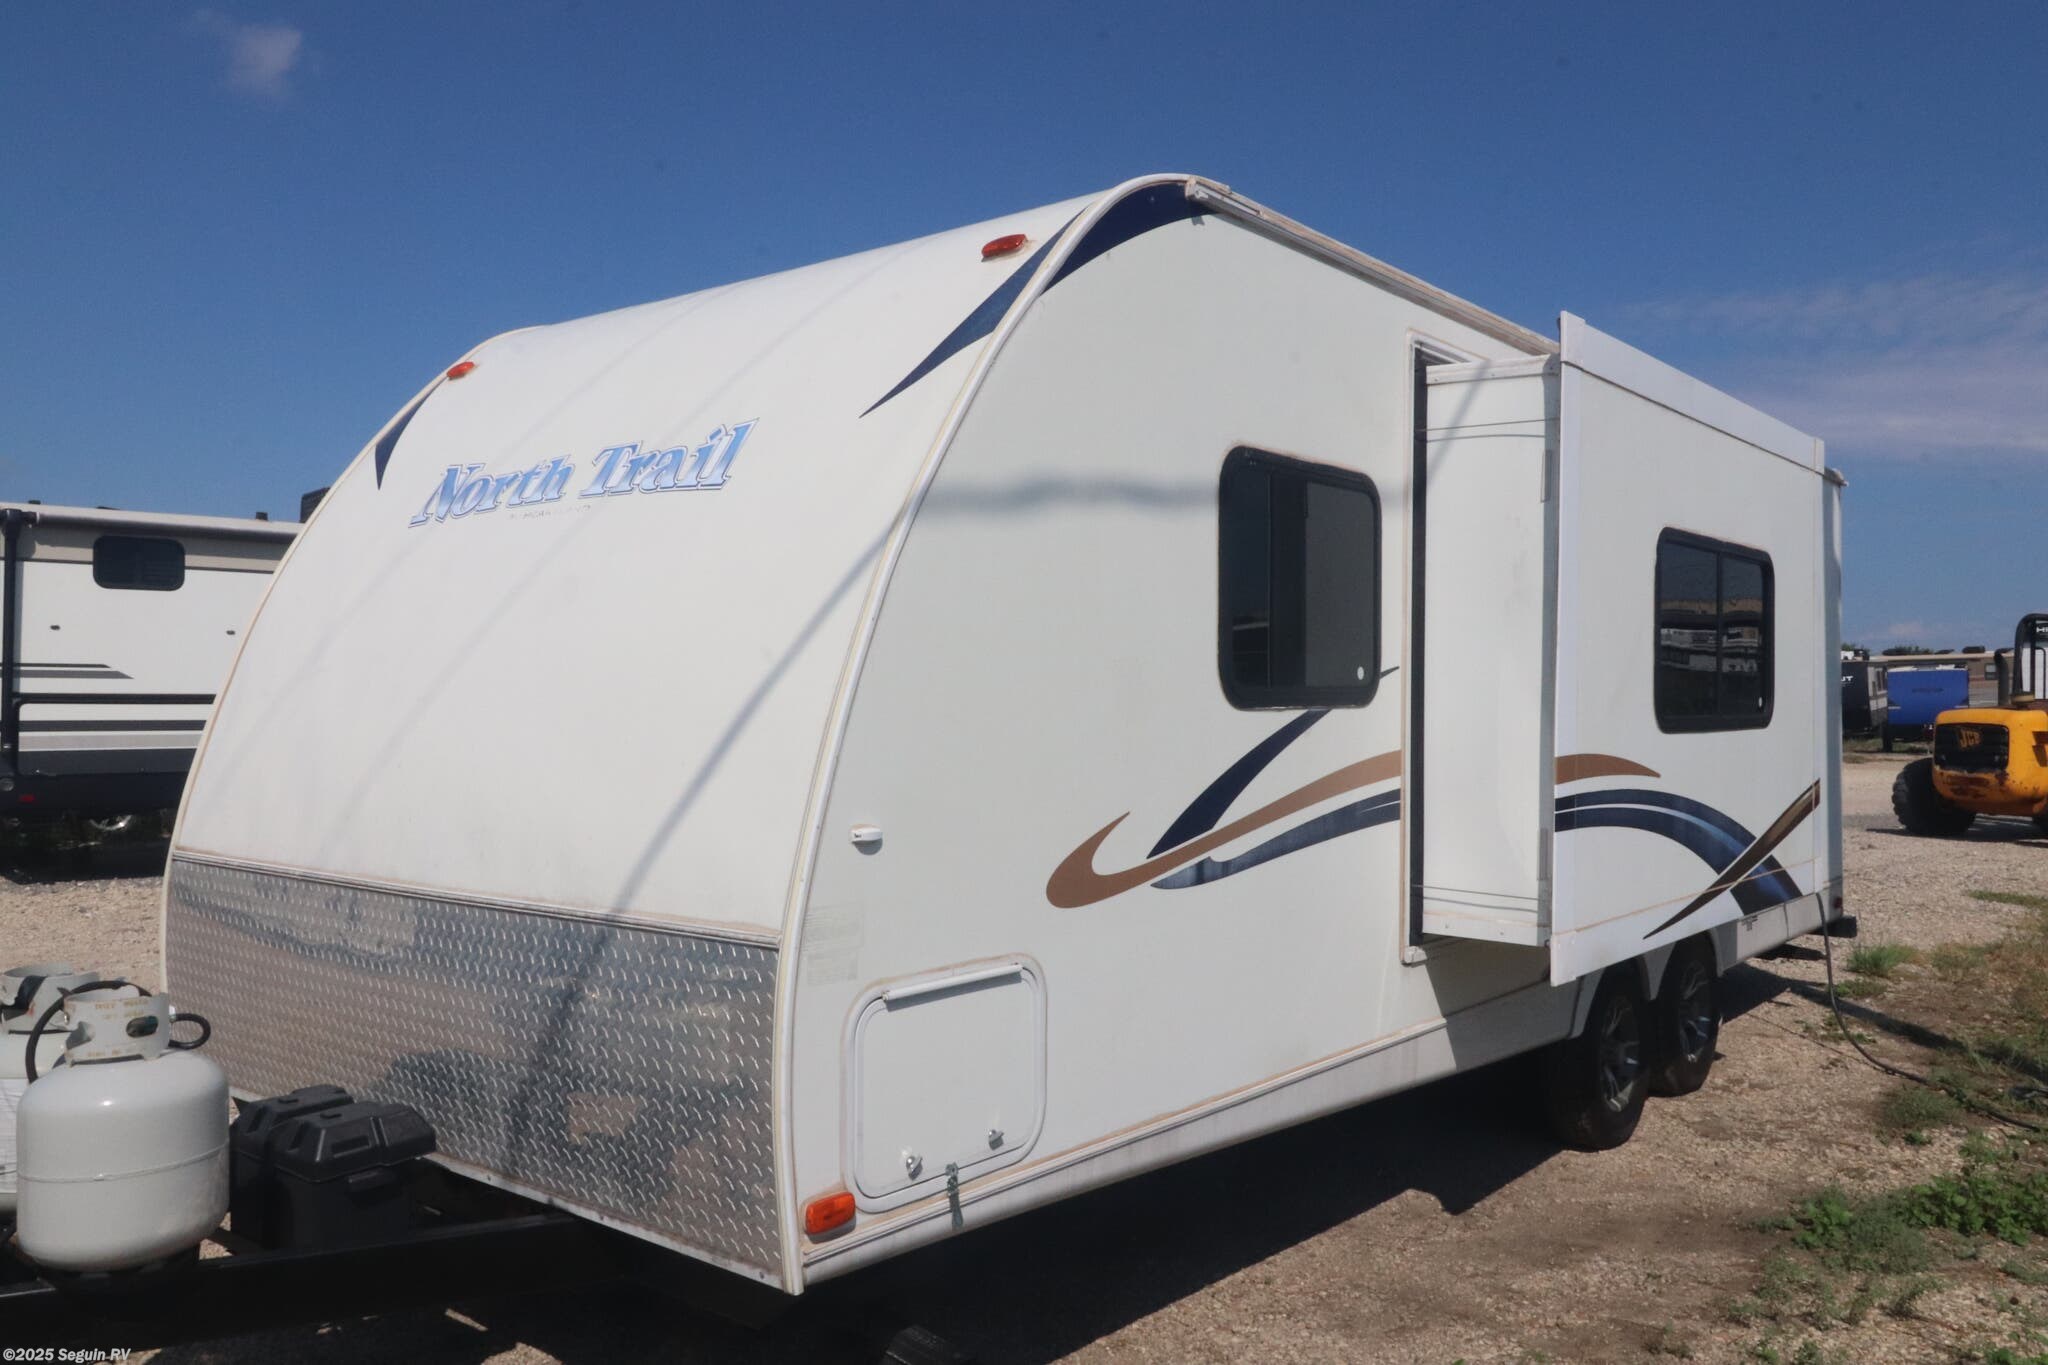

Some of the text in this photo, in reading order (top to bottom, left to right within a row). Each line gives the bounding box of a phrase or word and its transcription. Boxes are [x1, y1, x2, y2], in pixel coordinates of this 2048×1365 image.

[408, 418, 759, 528] North Trail
[1959, 729, 1982, 749] JCB
